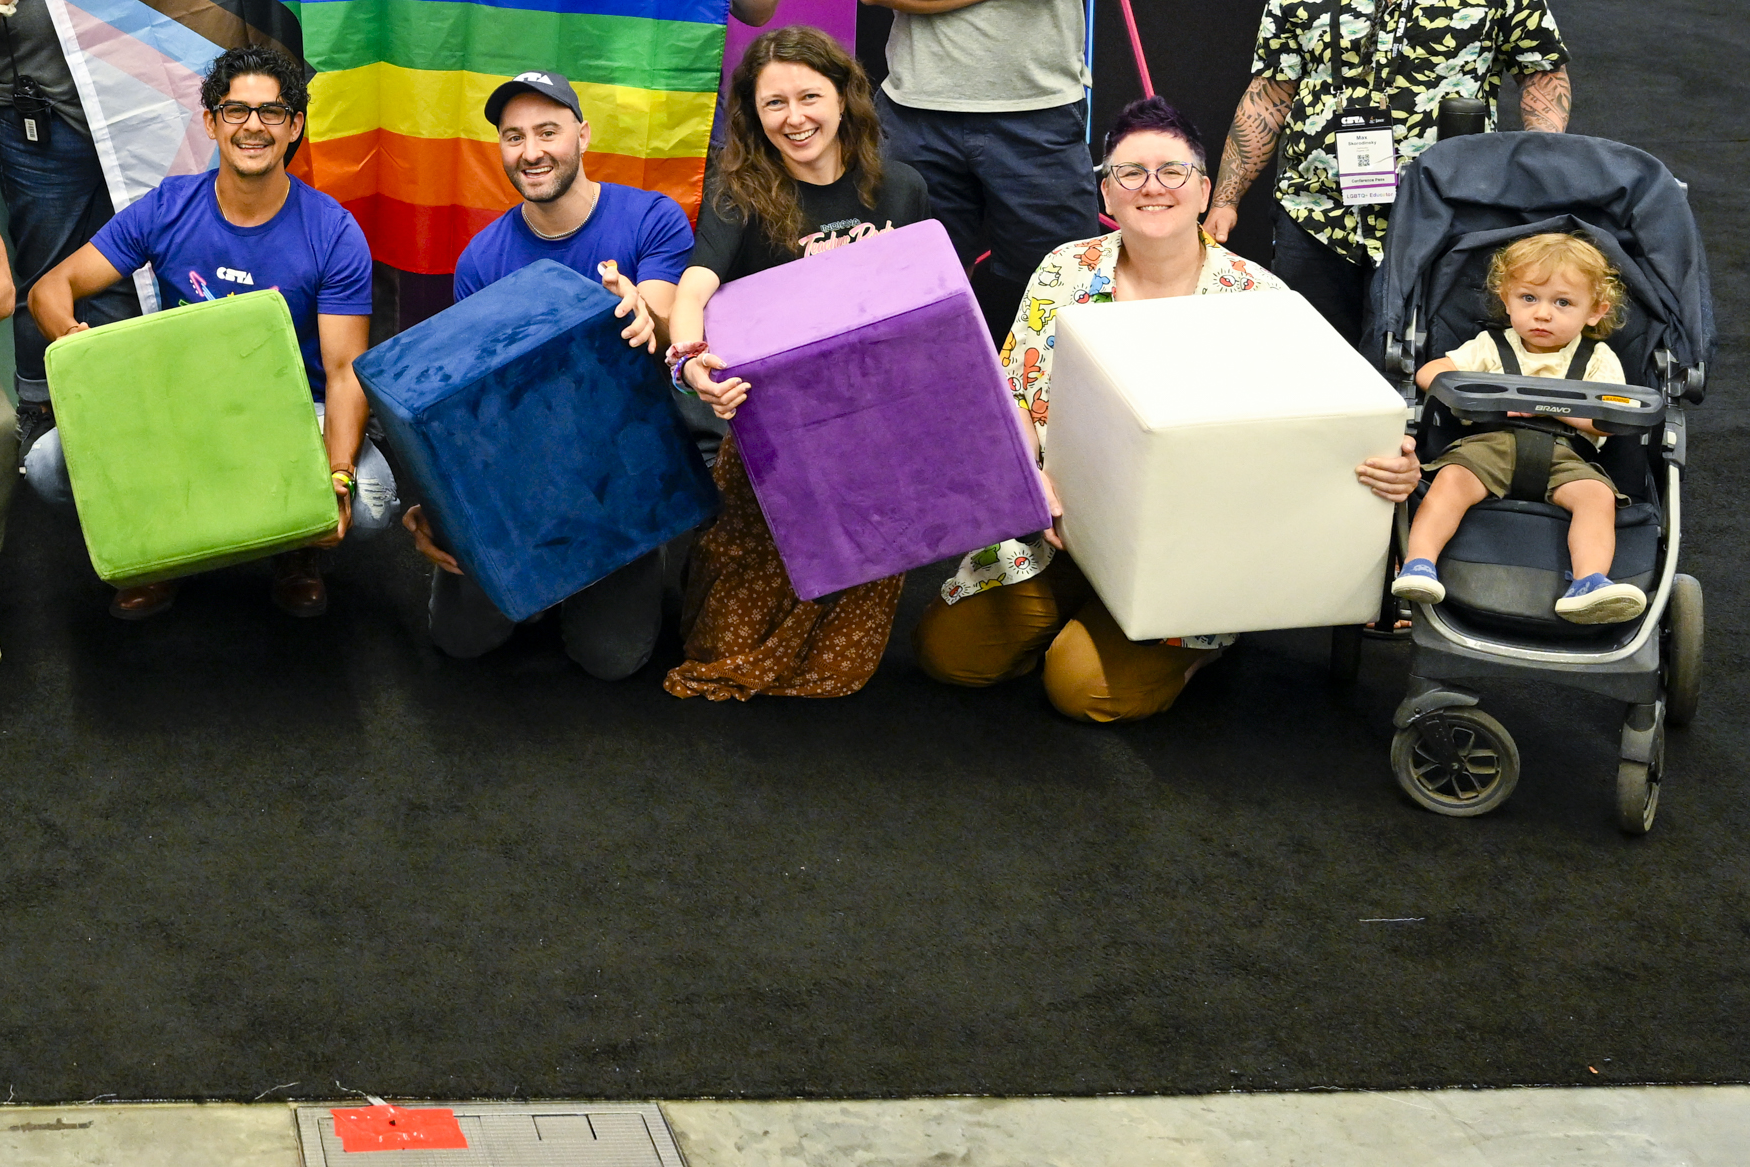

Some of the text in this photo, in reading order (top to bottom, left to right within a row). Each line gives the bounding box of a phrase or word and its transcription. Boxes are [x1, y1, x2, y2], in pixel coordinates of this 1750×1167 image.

[820, 218, 861, 232] INDIANA
[216, 266, 254, 285] CSTA
[1605, 396, 1630, 404] WARNING
[1535, 405, 1571, 413] BRAVO
